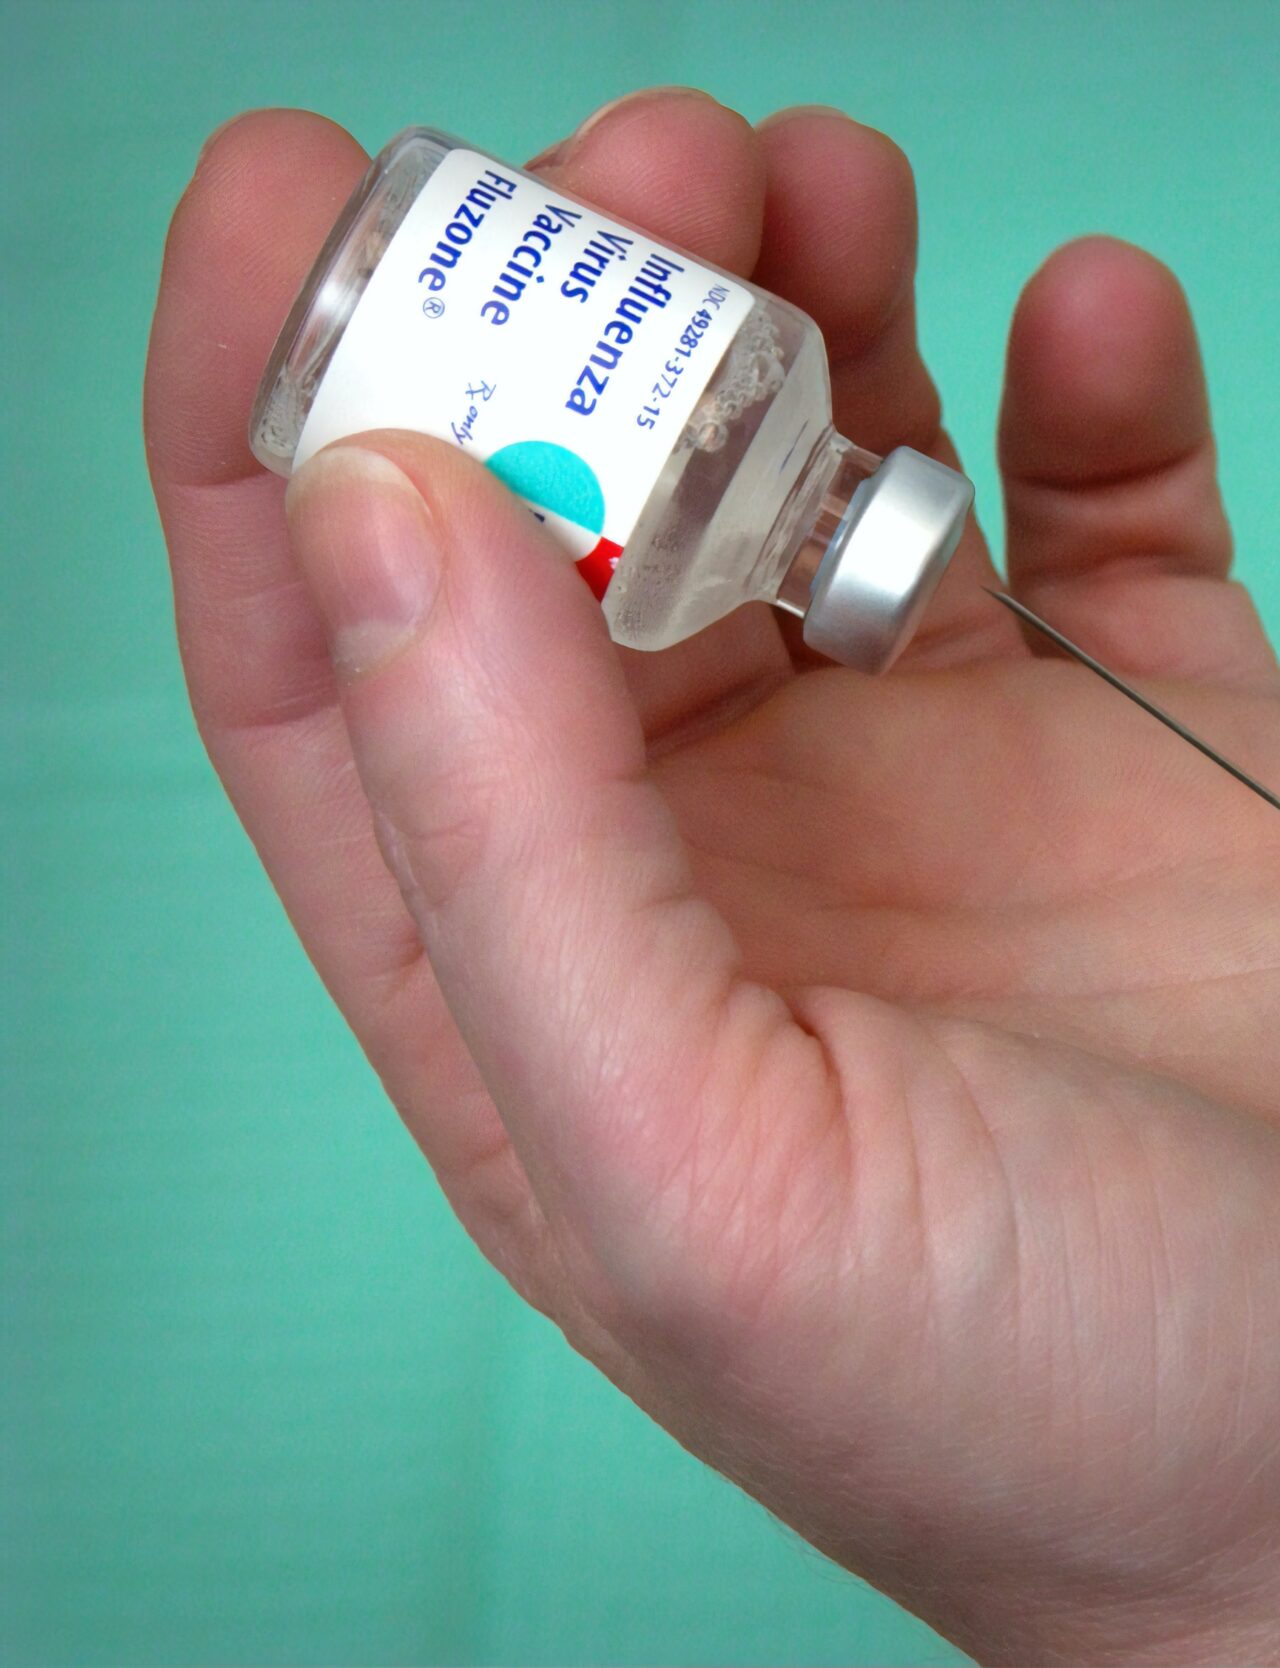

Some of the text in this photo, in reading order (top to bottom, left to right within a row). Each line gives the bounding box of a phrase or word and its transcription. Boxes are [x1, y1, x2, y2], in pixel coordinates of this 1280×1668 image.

[480, 204, 583, 327] Vaccine
[560, 230, 634, 304] Virus
[565, 253, 685, 417] Influenza
[636, 283, 730, 430] NDC 49281-372-15
